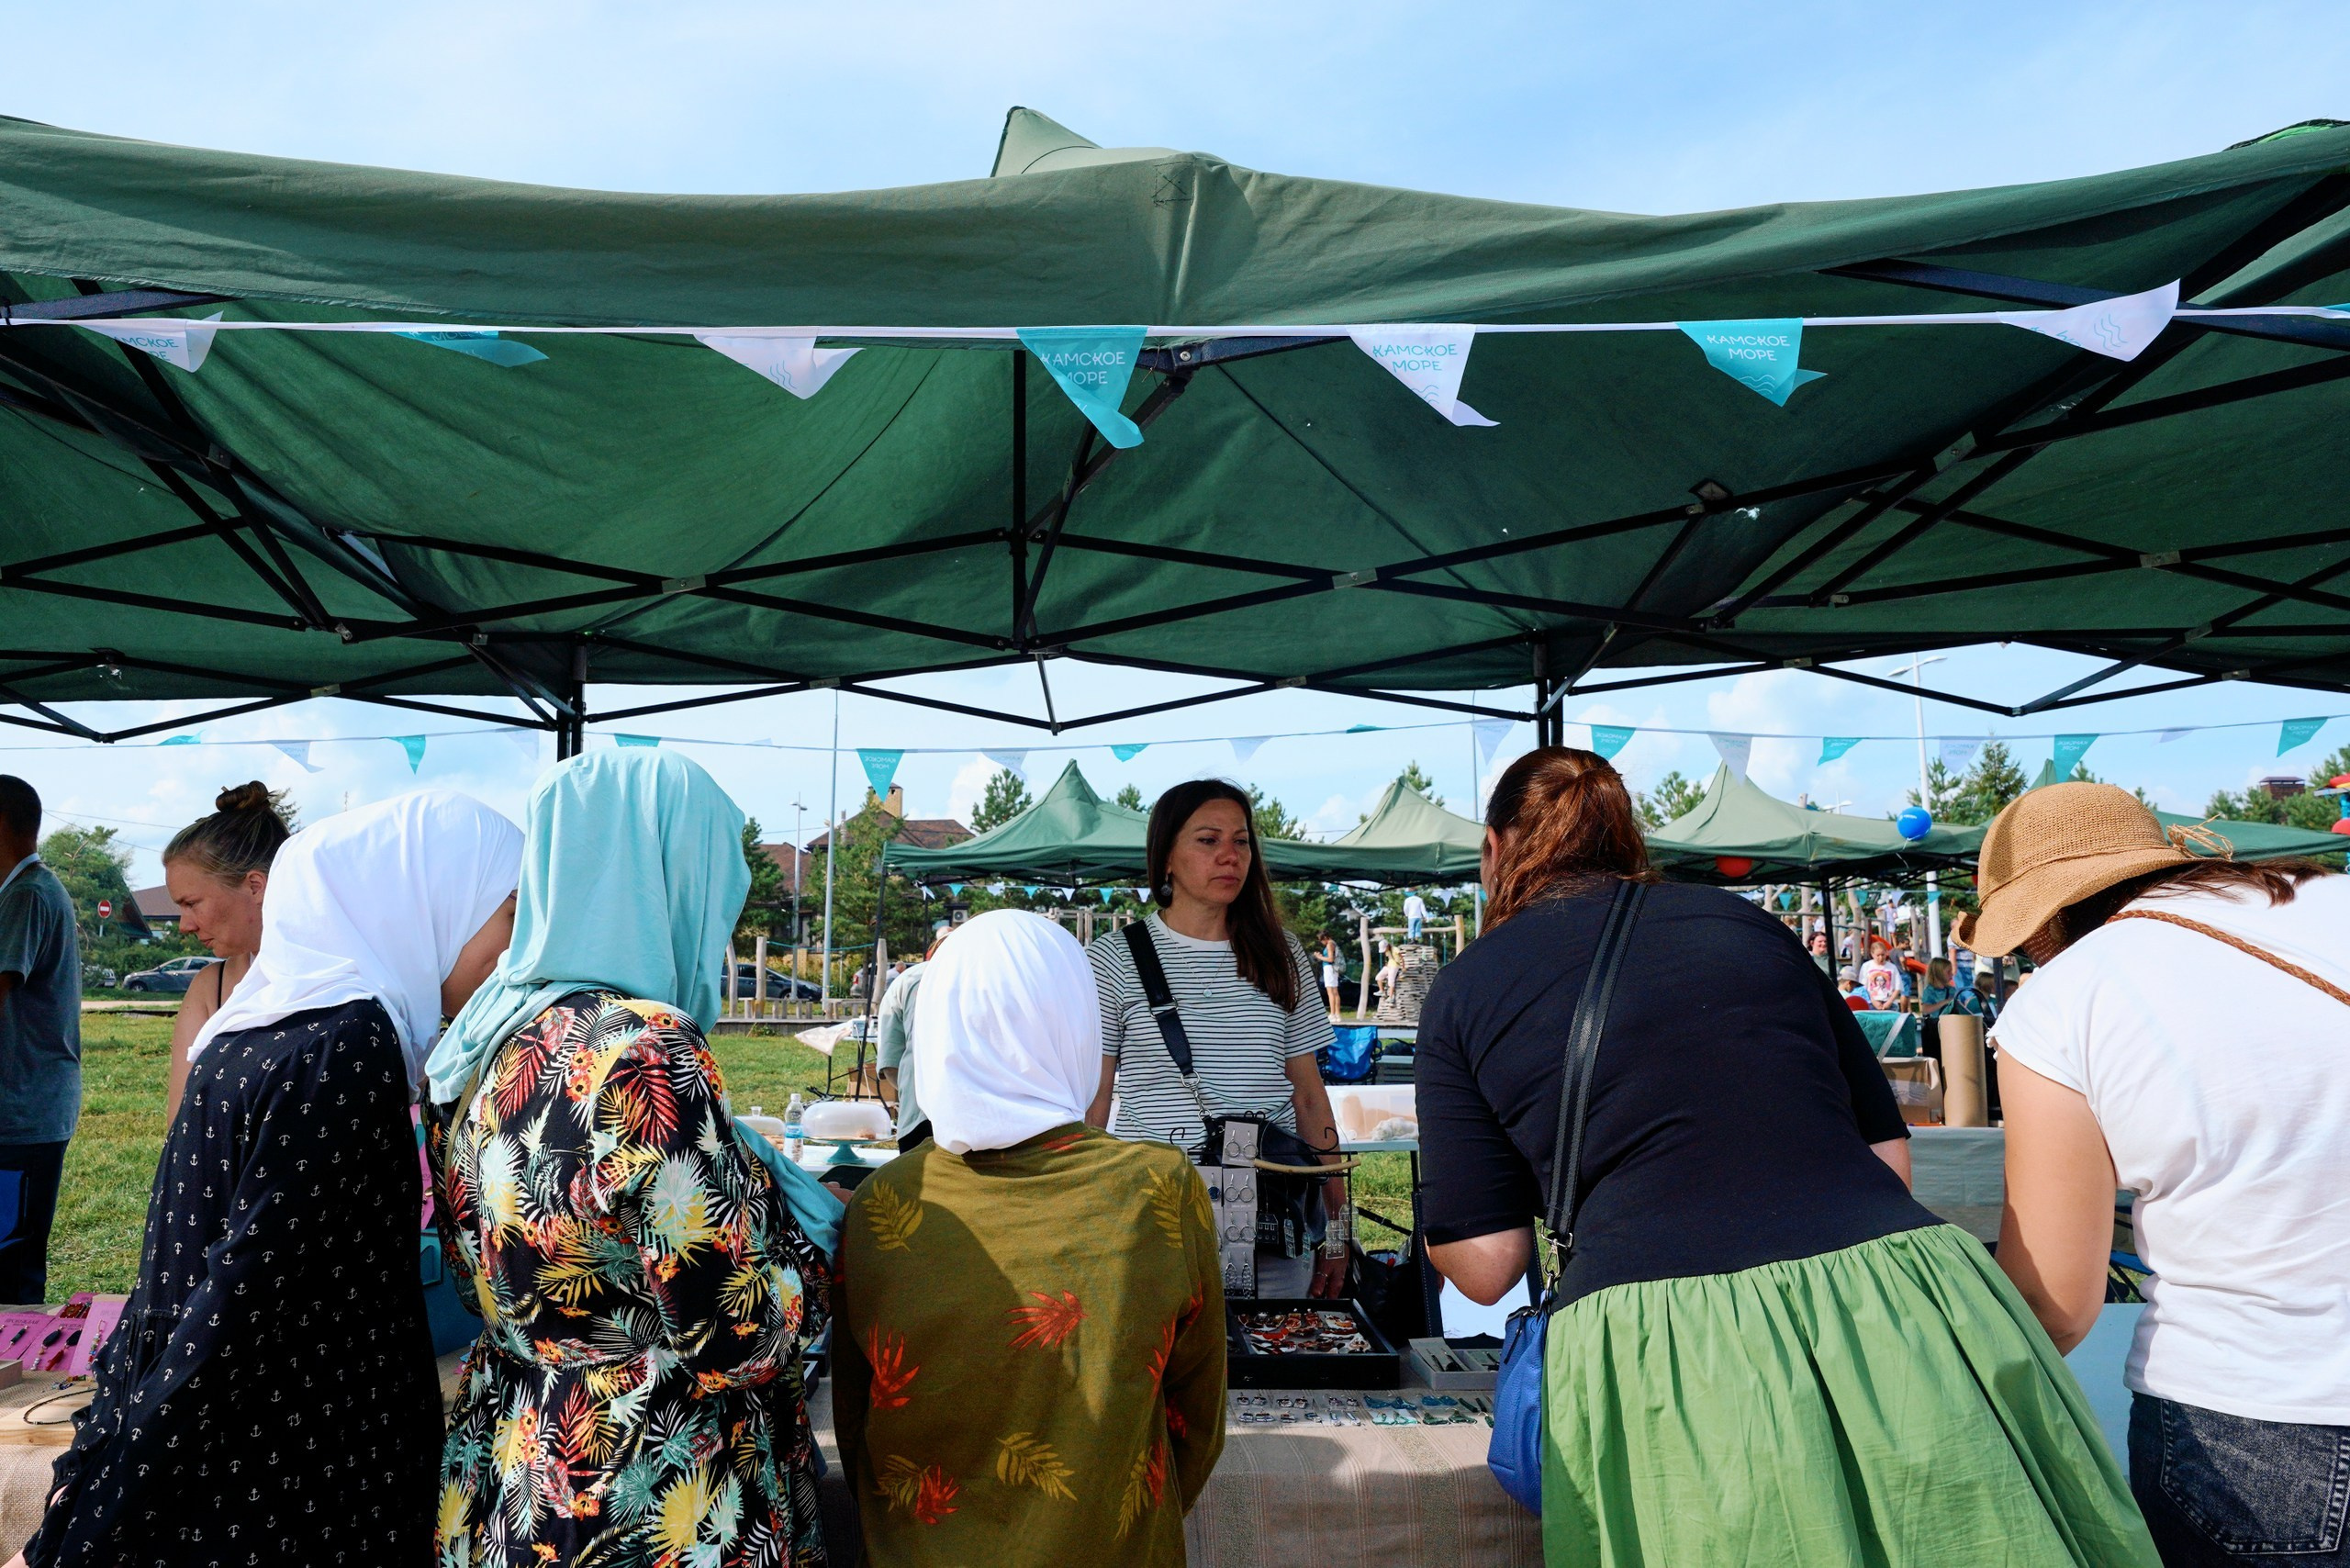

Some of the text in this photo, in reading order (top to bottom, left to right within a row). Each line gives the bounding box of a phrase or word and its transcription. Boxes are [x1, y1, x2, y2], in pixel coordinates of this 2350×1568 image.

[1707, 334, 1790, 347] КАМСКОЕ
[1372, 343, 1458, 357] КАМСКОЕ
[1729, 348, 1777, 361] МОРЕ
[1041, 352, 1125, 366] КАМСКОЕ
[1393, 359, 1442, 373] МОРЕ
